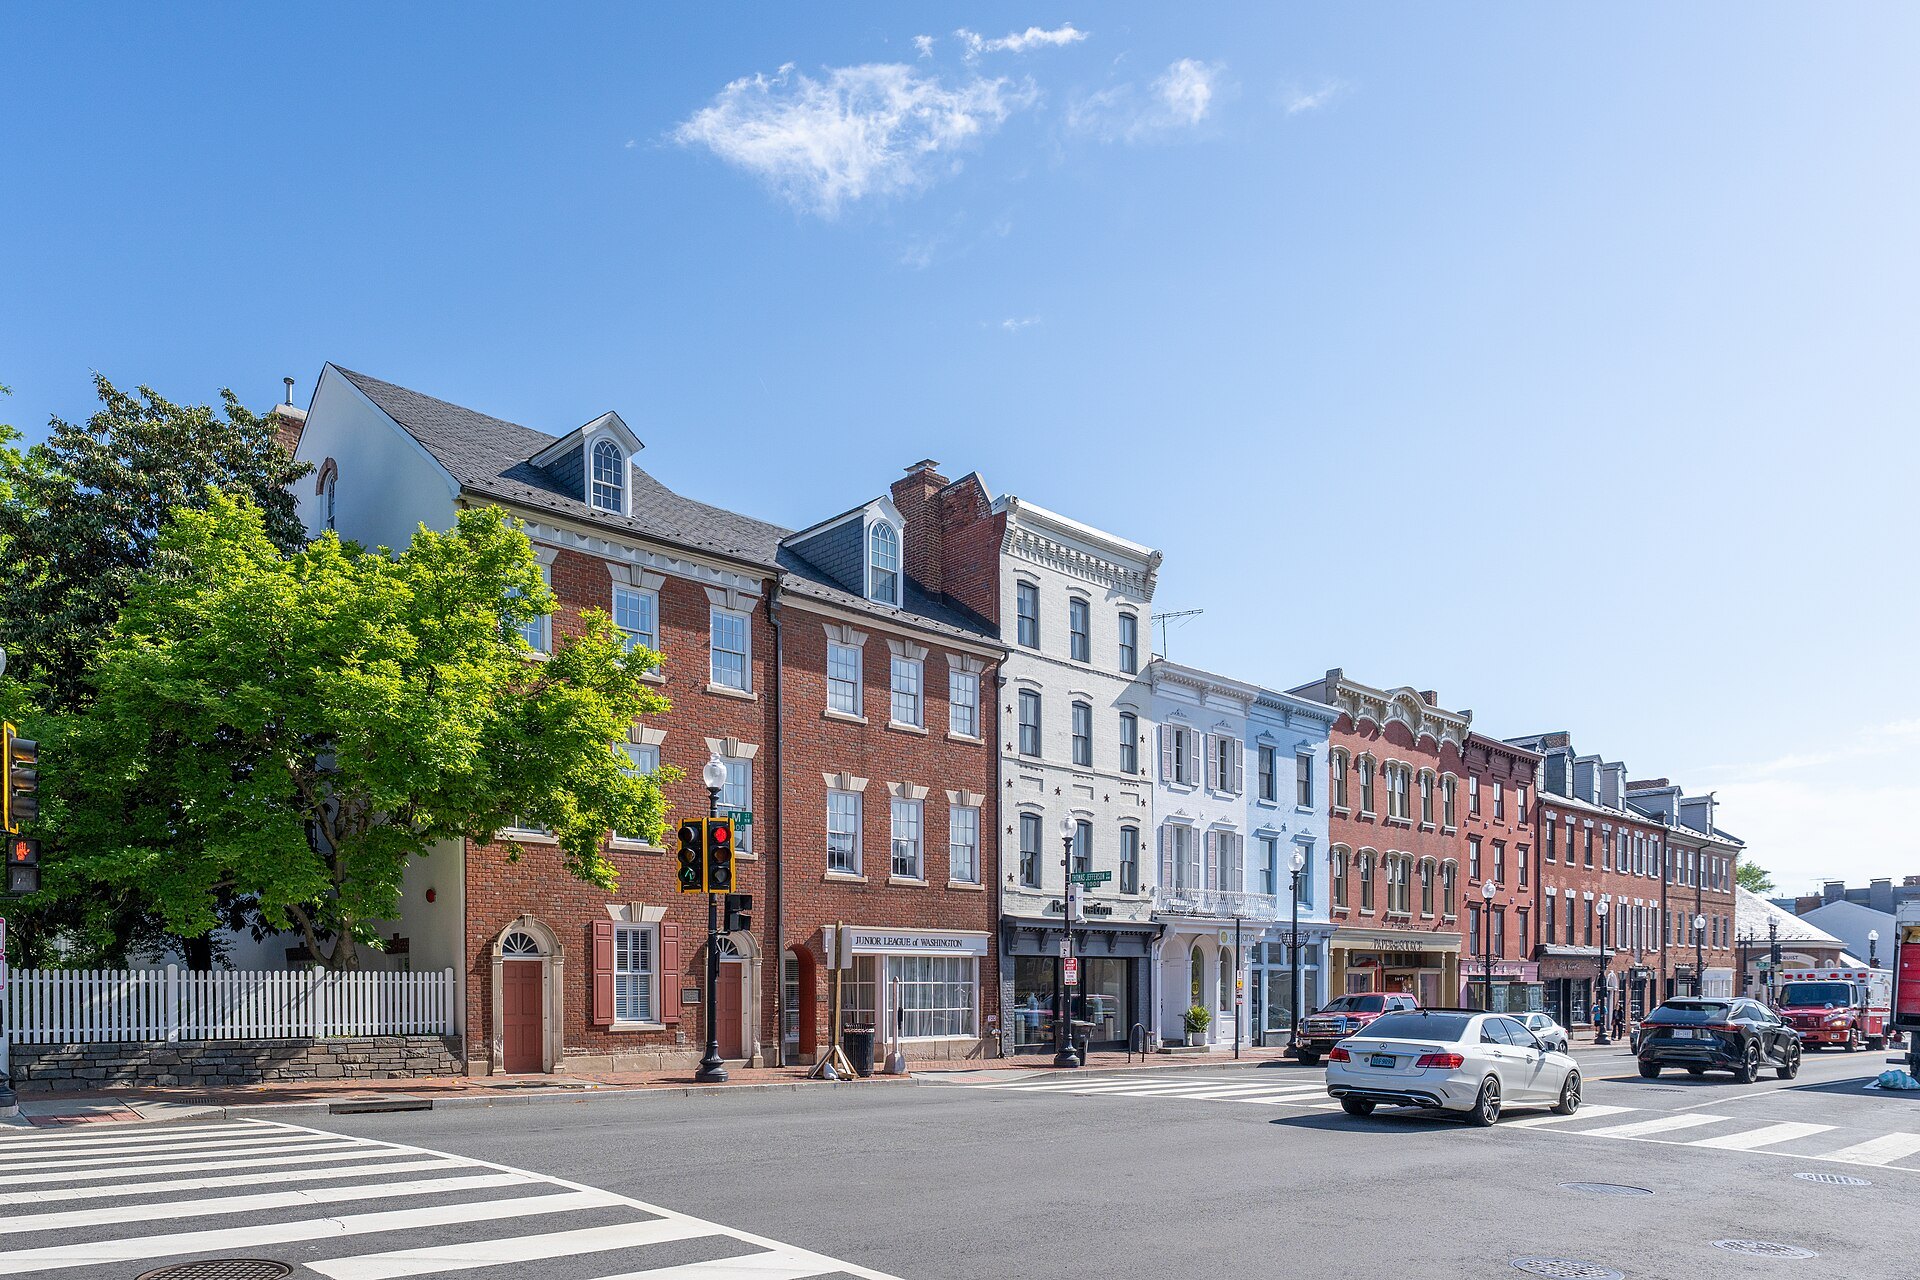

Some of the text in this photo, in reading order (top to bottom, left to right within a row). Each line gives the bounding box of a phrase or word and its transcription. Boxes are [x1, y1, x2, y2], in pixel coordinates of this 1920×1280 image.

[732, 812, 741, 823] M
[1071, 873, 1086, 882] THOMAS
[1086, 872, 1105, 881] JEFFERSON
[1052, 899, 1113, 916] Remation
[855, 936, 963, 948] JUNIOR LEAGUE of WASHINGTON
[1229, 931, 1255, 943] gojana
[1373, 938, 1423, 951] PAPER SOURCE
